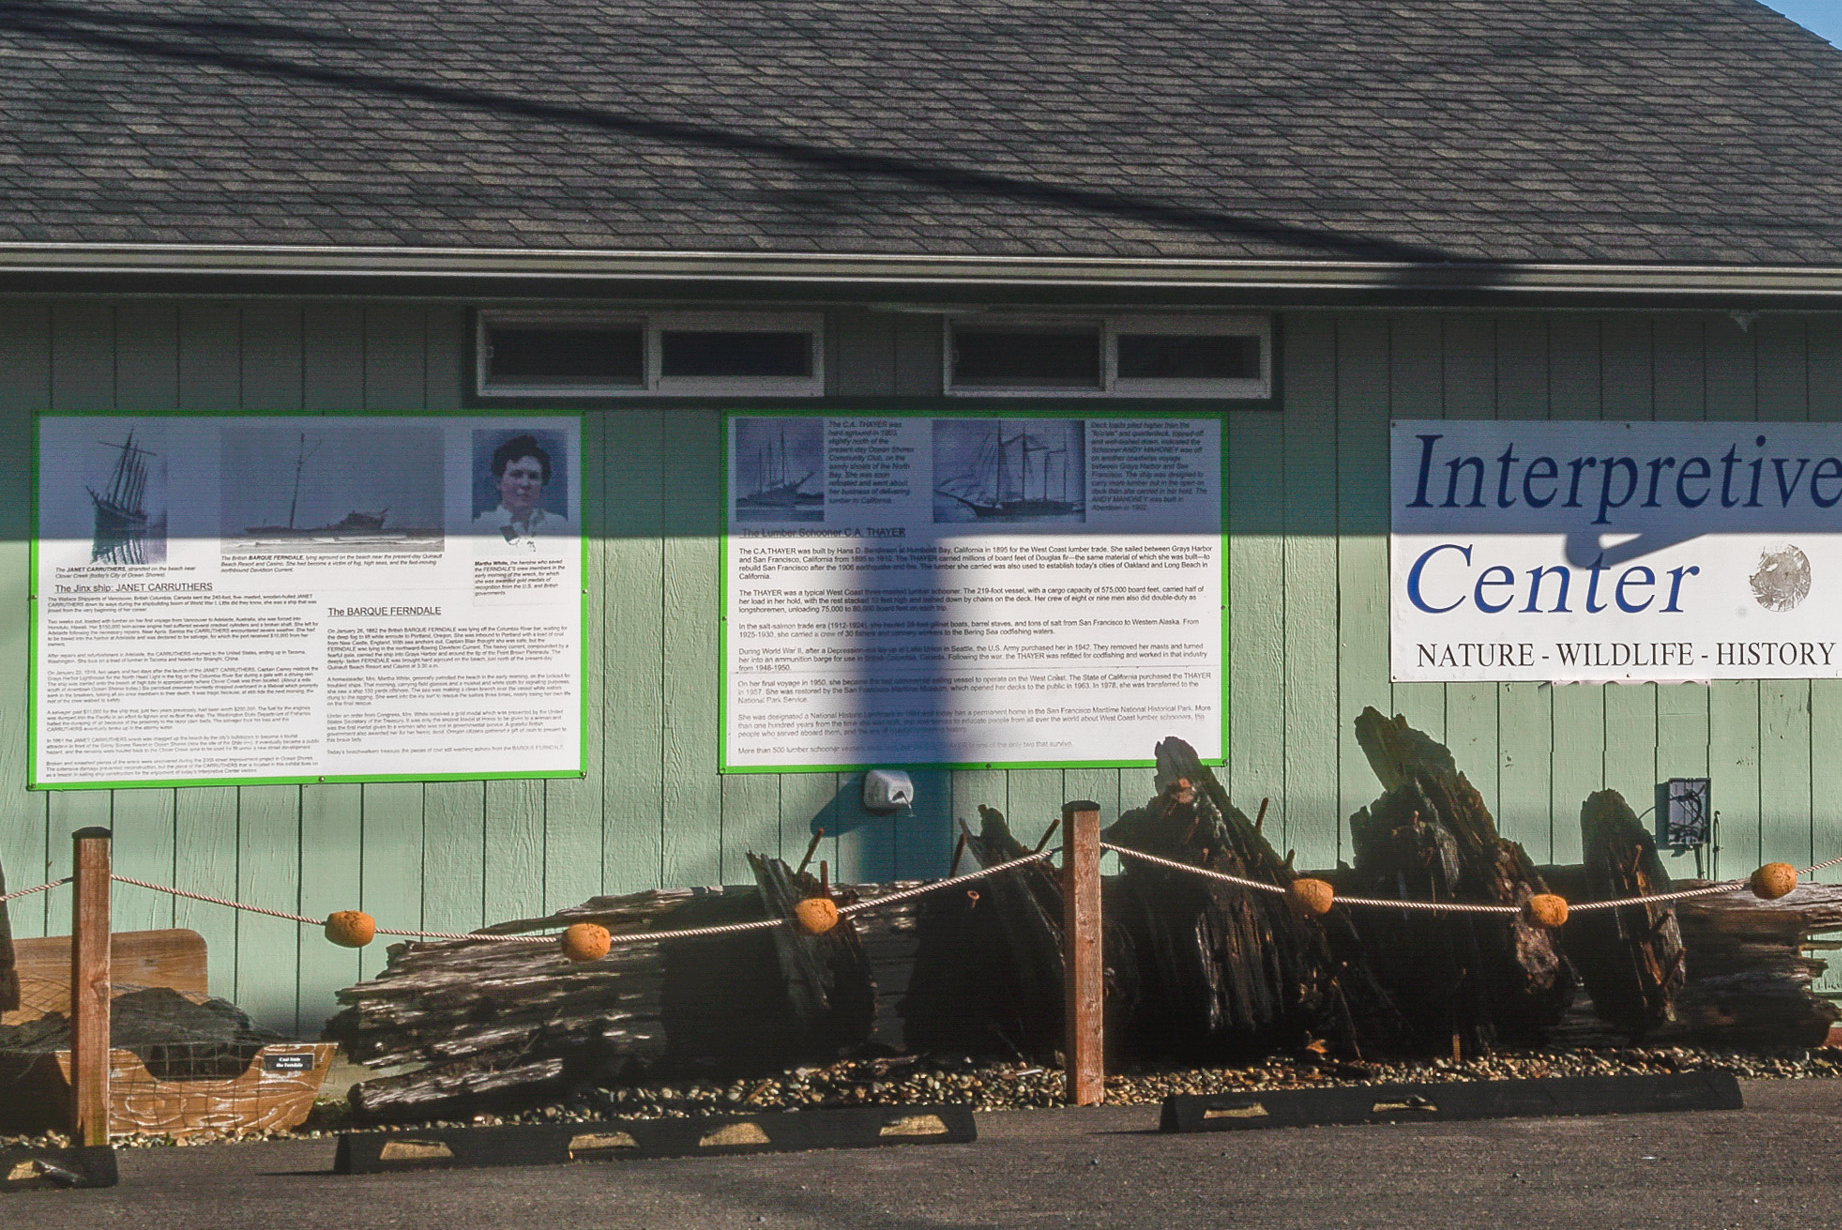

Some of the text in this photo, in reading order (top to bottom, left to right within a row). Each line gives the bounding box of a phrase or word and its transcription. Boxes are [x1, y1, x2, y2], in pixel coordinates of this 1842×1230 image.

[742, 529, 760, 538] The
[761, 529, 797, 538] Lumber
[798, 529, 842, 538] Schooner
[865, 529, 906, 538] THAYER
[1170, 545, 1190, 553] Grays
[1034, 554, 1061, 563] Douglas
[1074, 563, 1097, 571] today's
[1407, 543, 1701, 614] Center
[55, 583, 213, 594] The Jinx ship: JANET CARRUTHERS
[328, 607, 441, 618] The BARQUE FERNDALE
[1416, 642, 1534, 668] NATURE
[1557, 642, 1694, 667] WILDLIFE
[1716, 641, 1836, 666] HISTORY
